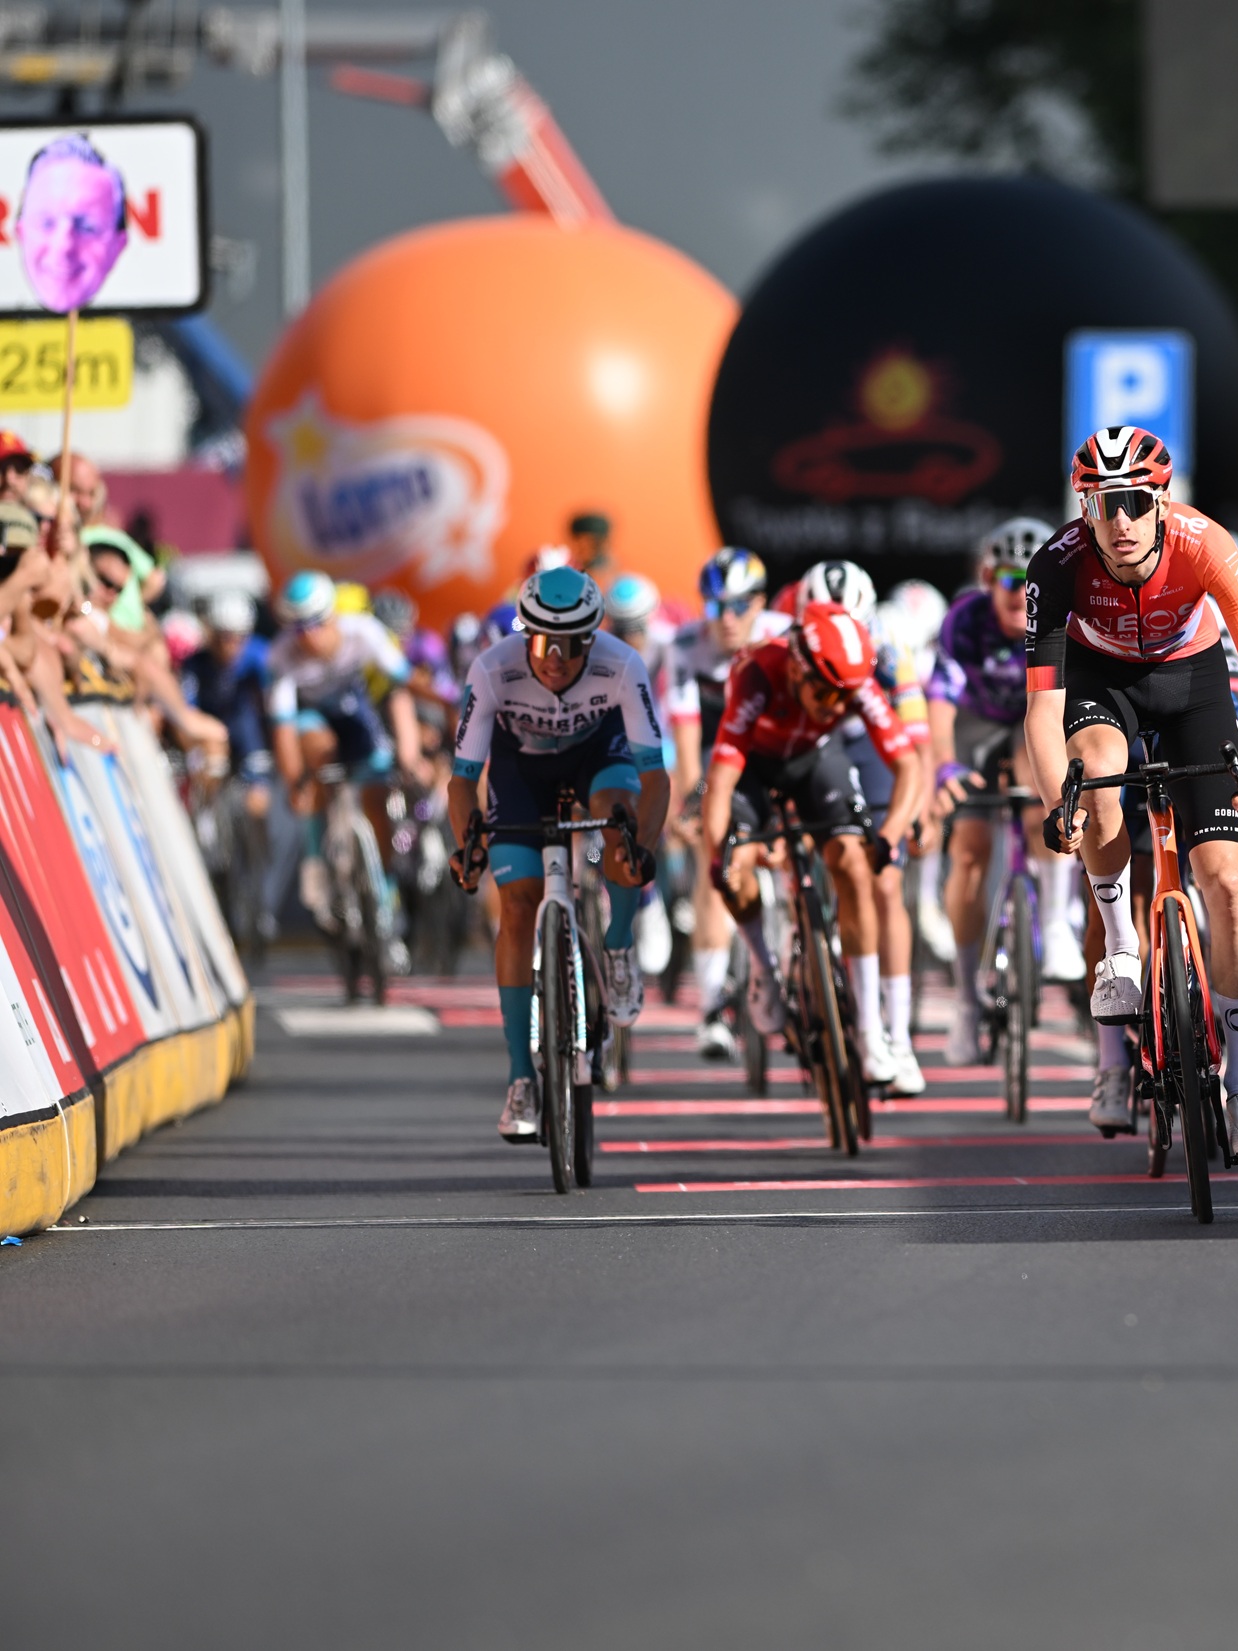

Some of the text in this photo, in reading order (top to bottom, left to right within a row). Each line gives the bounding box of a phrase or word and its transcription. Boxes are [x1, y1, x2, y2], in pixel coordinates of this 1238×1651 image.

[1025, 580, 1040, 652] INEOS
[1090, 596, 1119, 607] GOBIK
[456, 692, 477, 756] MERIDA
[502, 706, 613, 729] BAHRAIN
